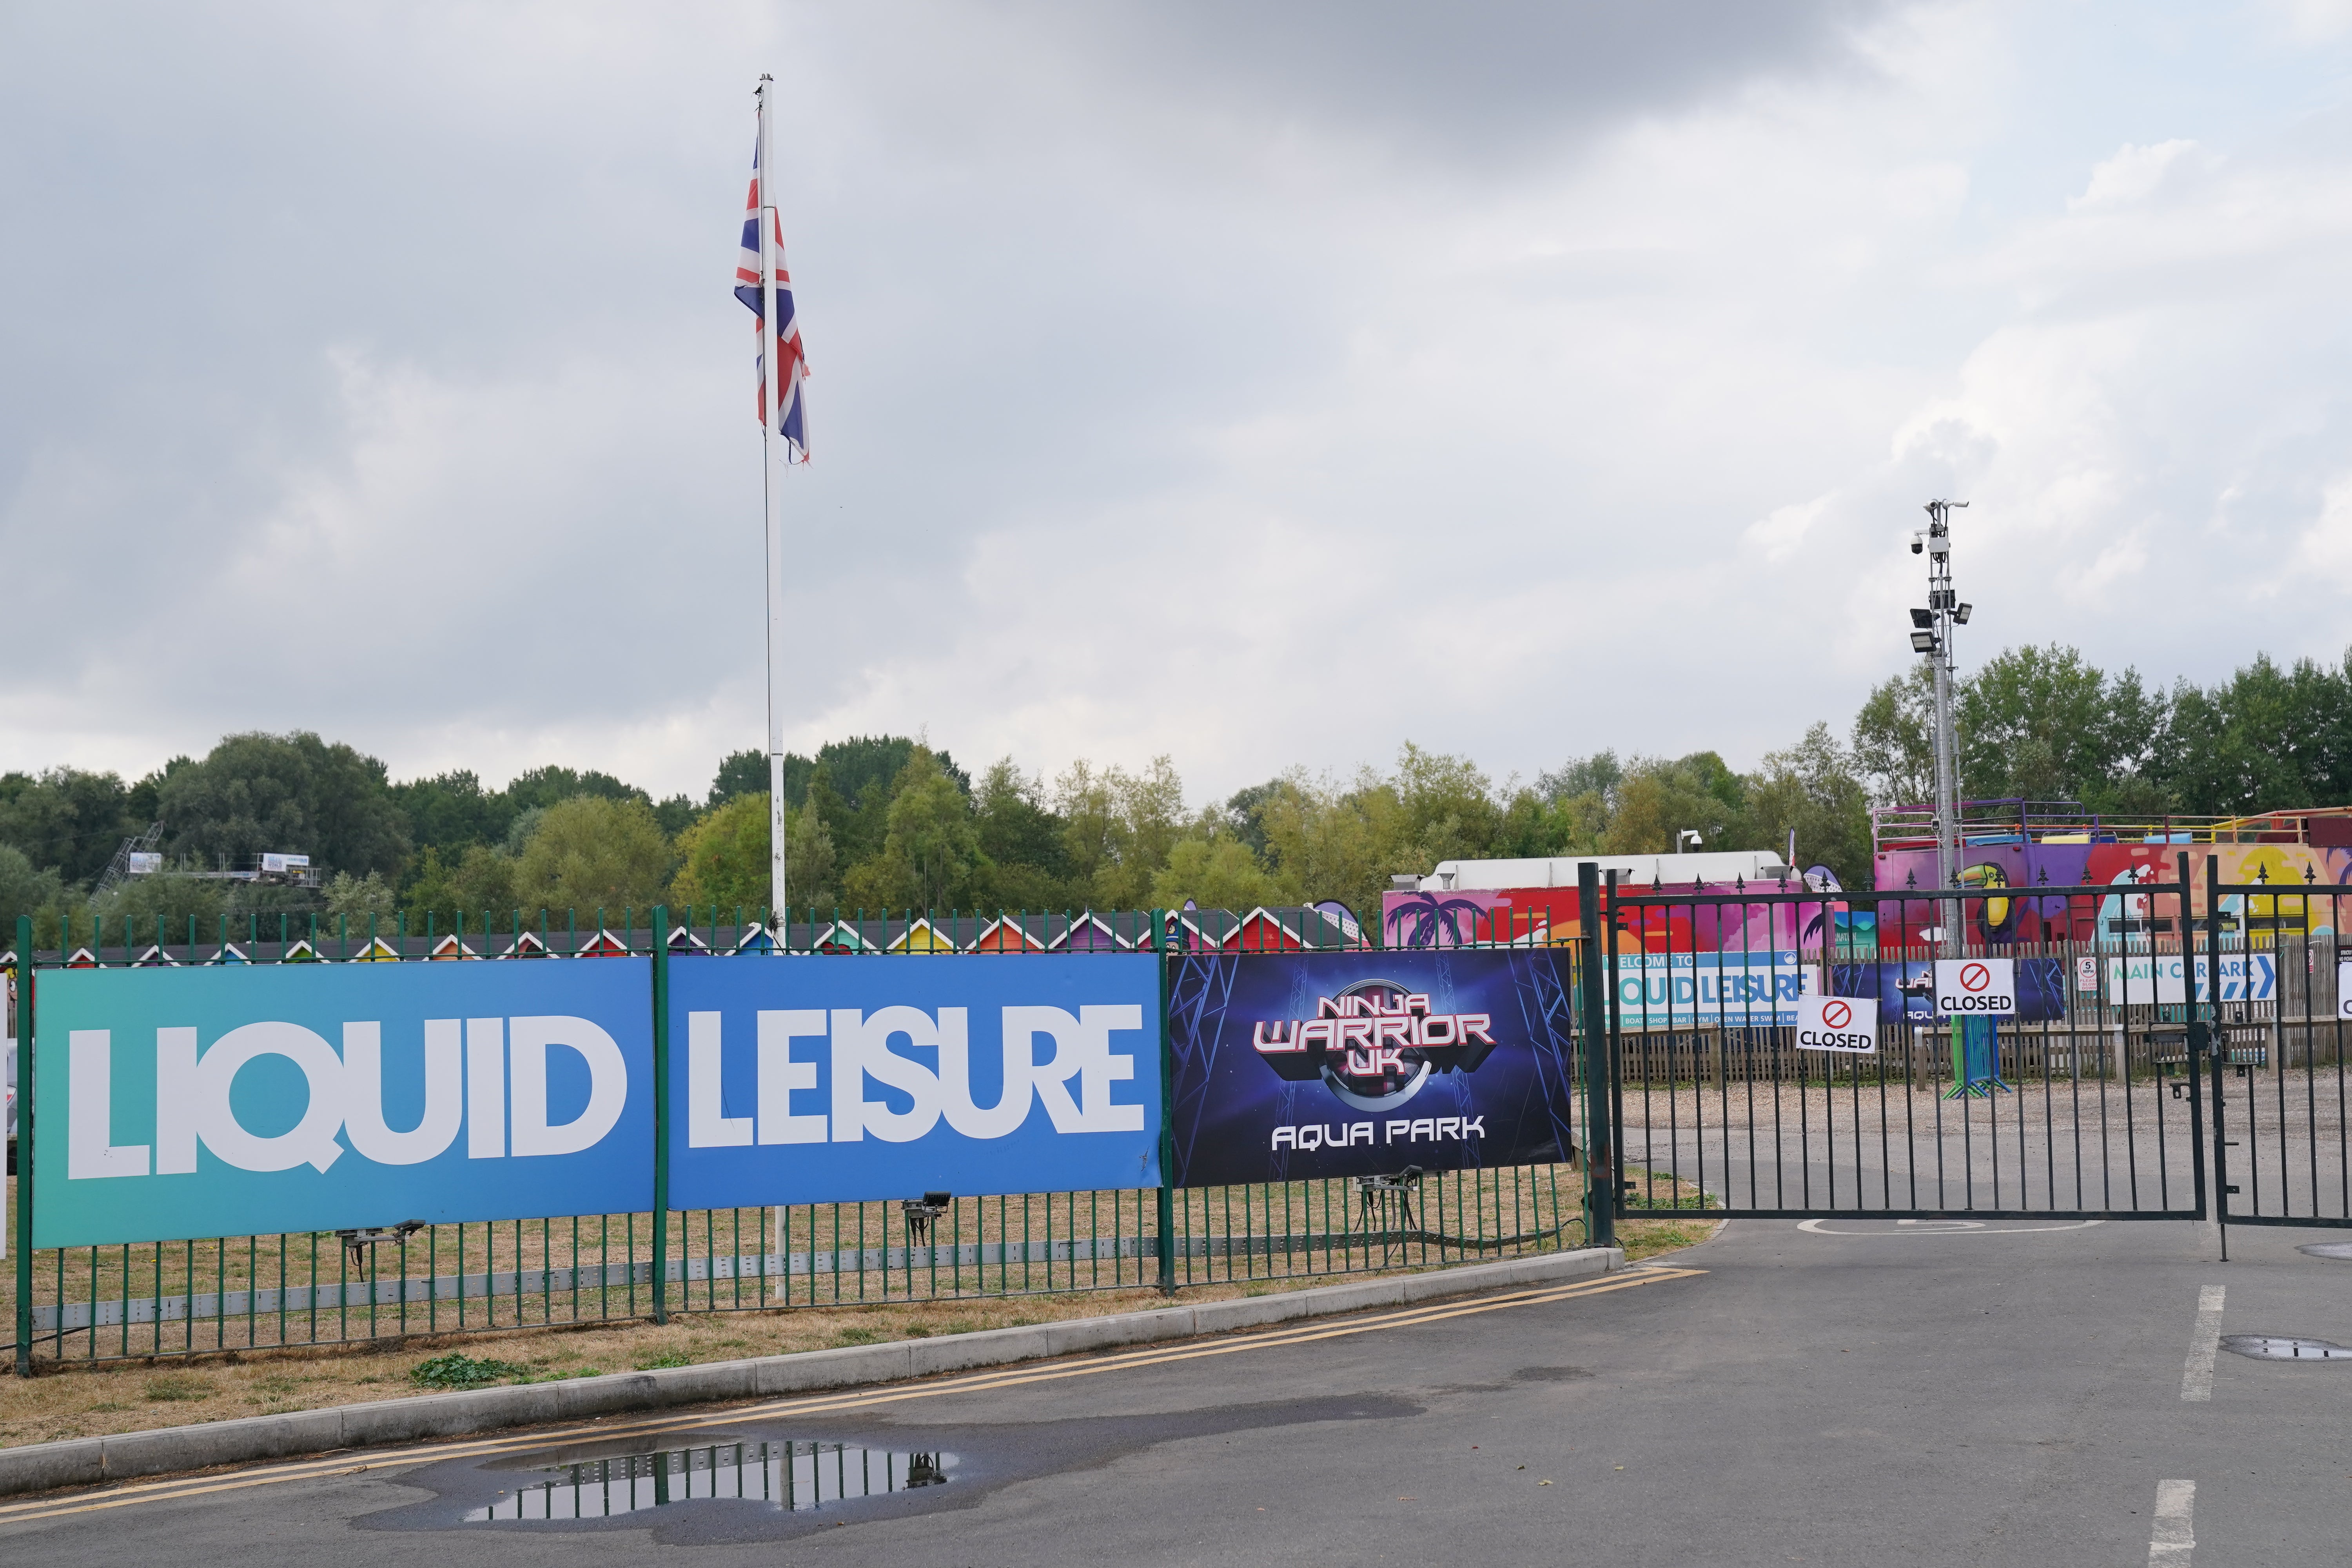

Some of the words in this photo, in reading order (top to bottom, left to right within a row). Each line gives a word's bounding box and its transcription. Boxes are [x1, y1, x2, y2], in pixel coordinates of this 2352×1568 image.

[1835, 932, 1857, 942] MATIN
[1606, 955, 1672, 968] ELCOM
[1676, 955, 1693, 966] TO
[2114, 963, 2163, 979] MAIN
[2170, 962, 2207, 978] CR
[2219, 961, 2255, 977] ARK
[1604, 976, 1698, 1006] QUID
[1941, 996, 2011, 1011] CLOSED
[1318, 993, 1431, 1019] NINJA
[1252, 1013, 1497, 1053] WARRIOR
[1800, 1031, 1871, 1049] CLOSED
[1347, 1047, 1406, 1076] UK
[68, 1015, 627, 1180] LIQUID
[689, 1004, 1144, 1148] LEISURE
[1272, 1122, 1374, 1151] AQUA
[1386, 1116, 1485, 1144] PARK
